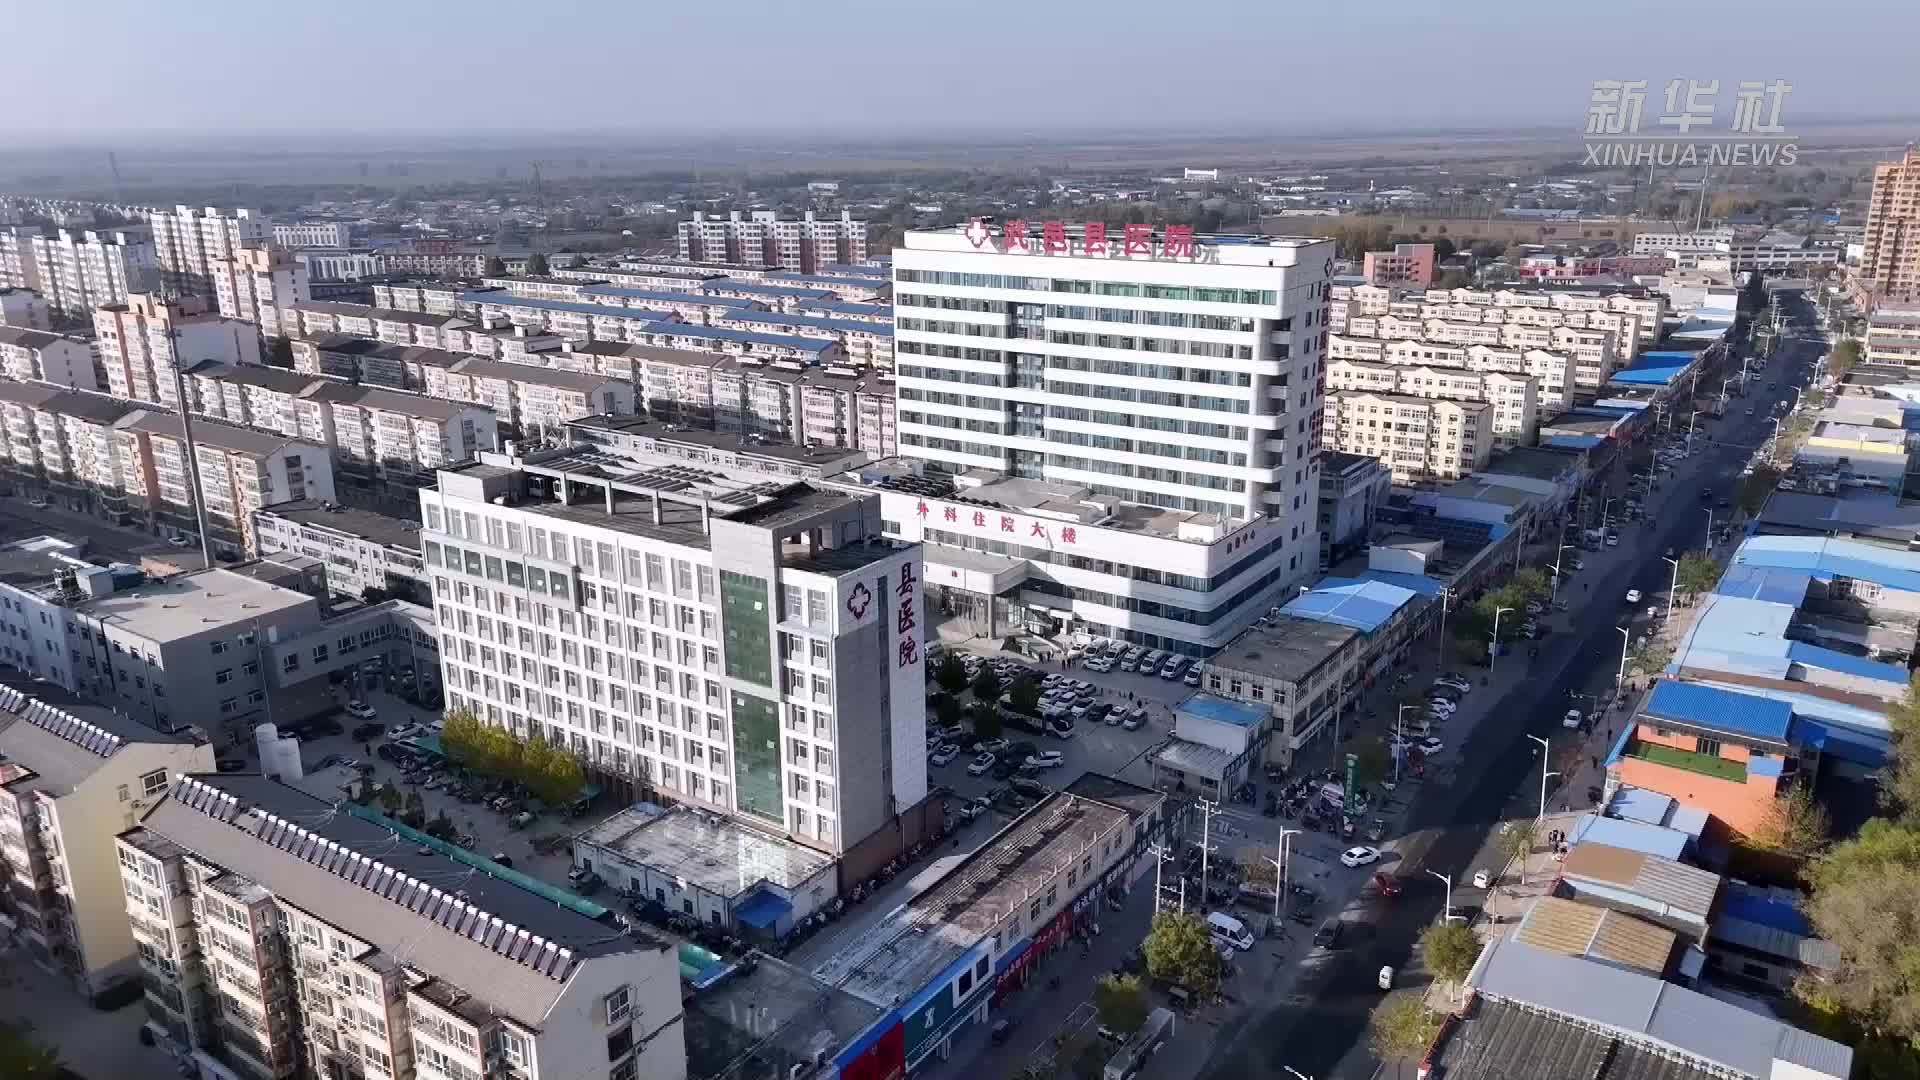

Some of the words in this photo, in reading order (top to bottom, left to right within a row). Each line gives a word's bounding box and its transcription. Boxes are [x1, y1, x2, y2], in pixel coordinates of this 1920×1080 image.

[1004, 219, 1194, 258] 武邑县医院
[916, 501, 1077, 545] 外科住院大楼
[895, 561, 918, 668] 县医院
